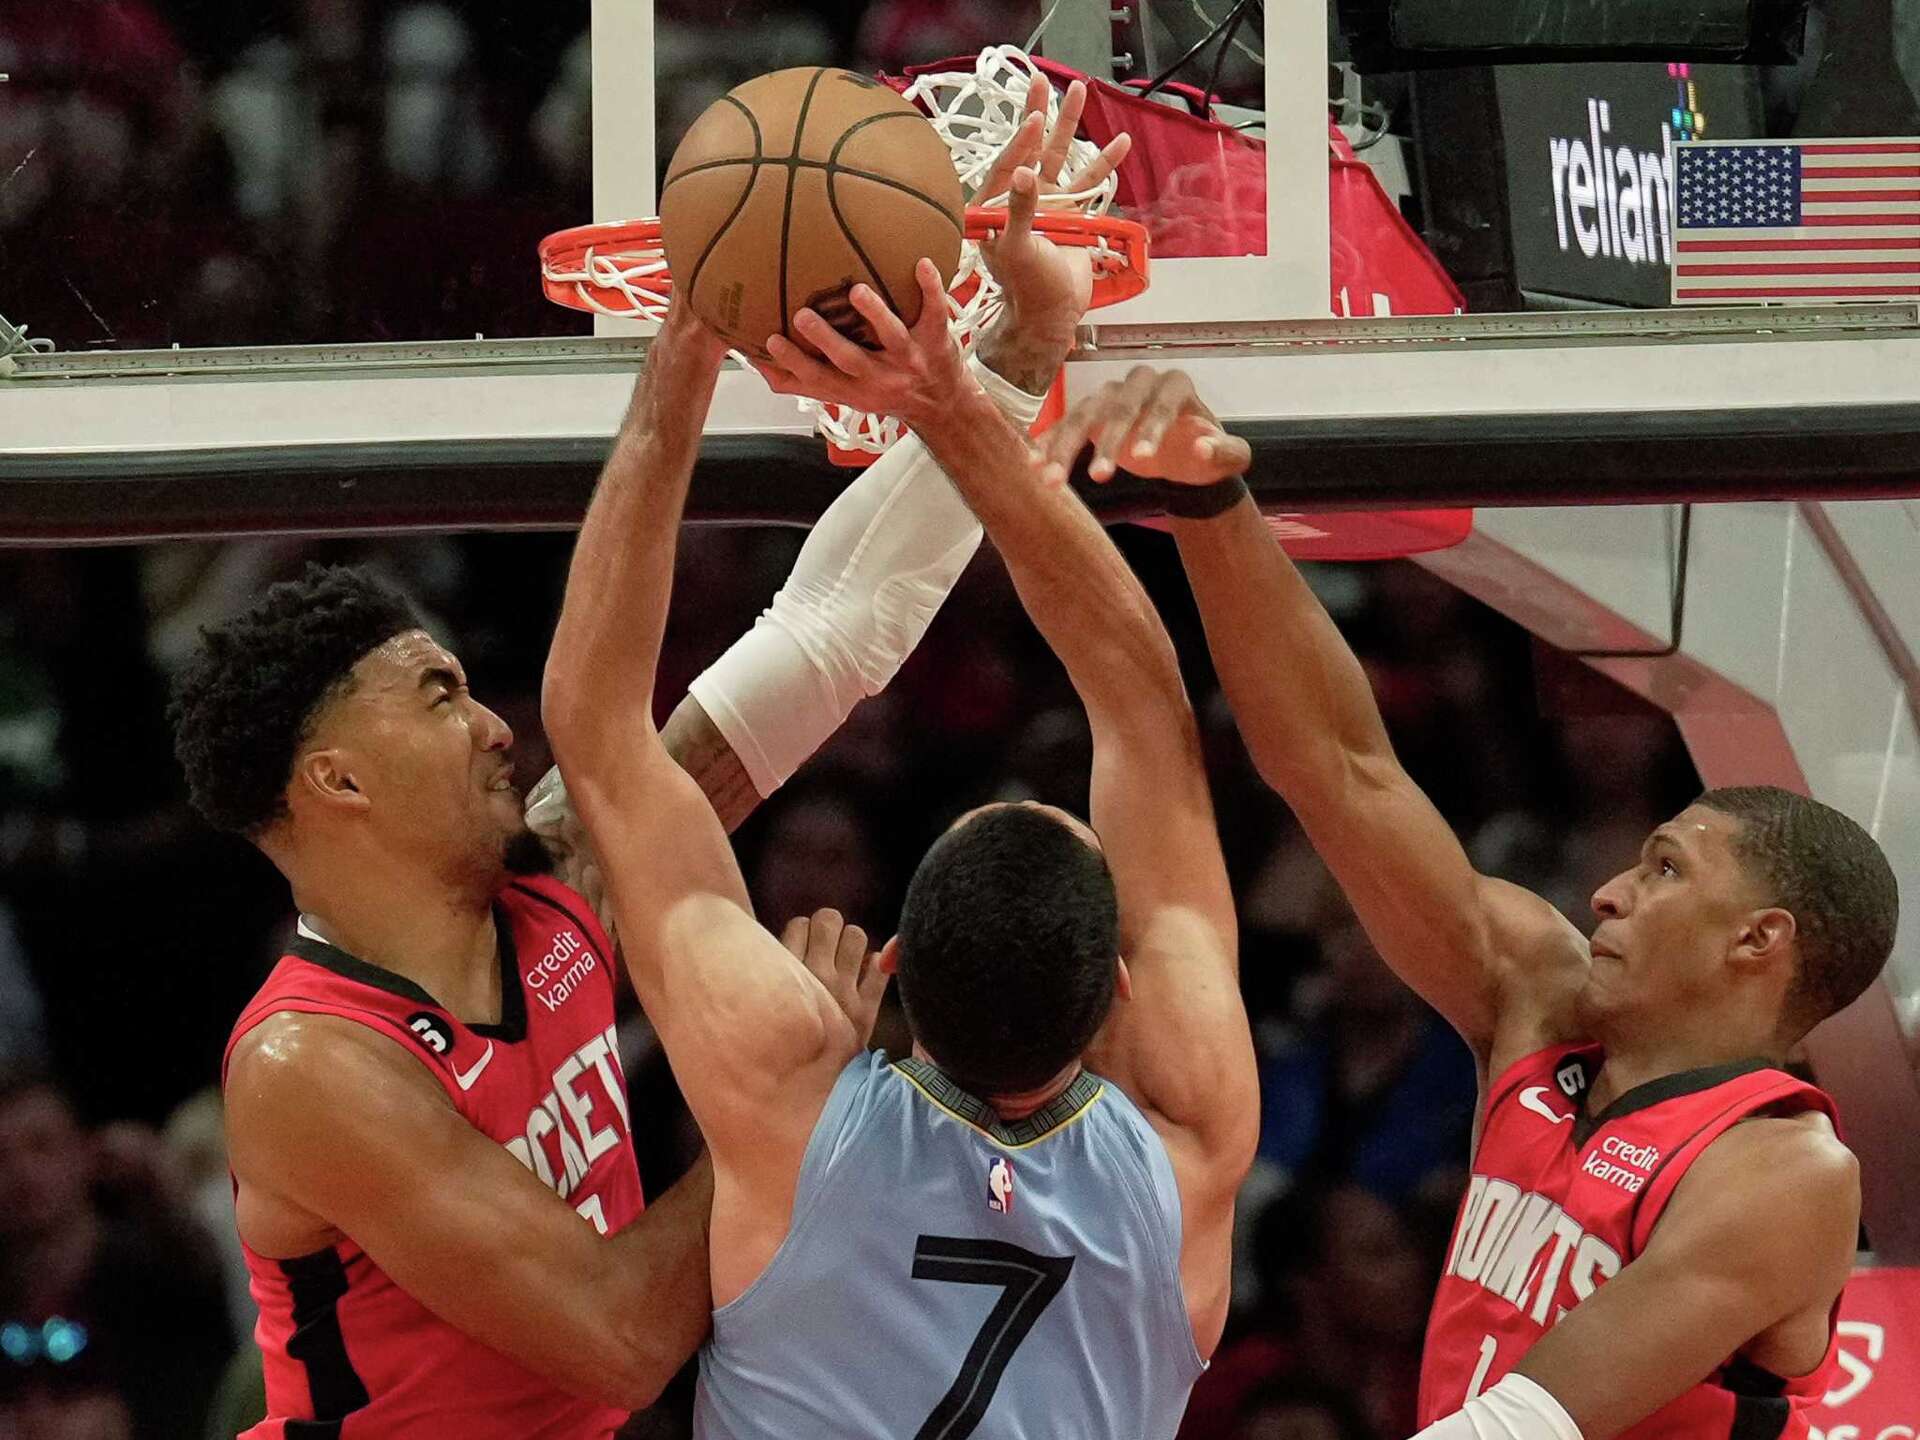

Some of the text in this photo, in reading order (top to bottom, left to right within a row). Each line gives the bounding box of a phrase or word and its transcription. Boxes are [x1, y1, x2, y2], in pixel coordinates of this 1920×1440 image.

[526, 930, 581, 989] credit
[536, 950, 596, 1012] karma
[1557, 1063, 1585, 1097] 6
[504, 1024, 631, 1200] CKET
[1582, 1149, 1646, 1193] karma
[1602, 1135, 1659, 1172] credit
[911, 1234, 1076, 1440] 7
[1463, 1334, 1498, 1407] 1
